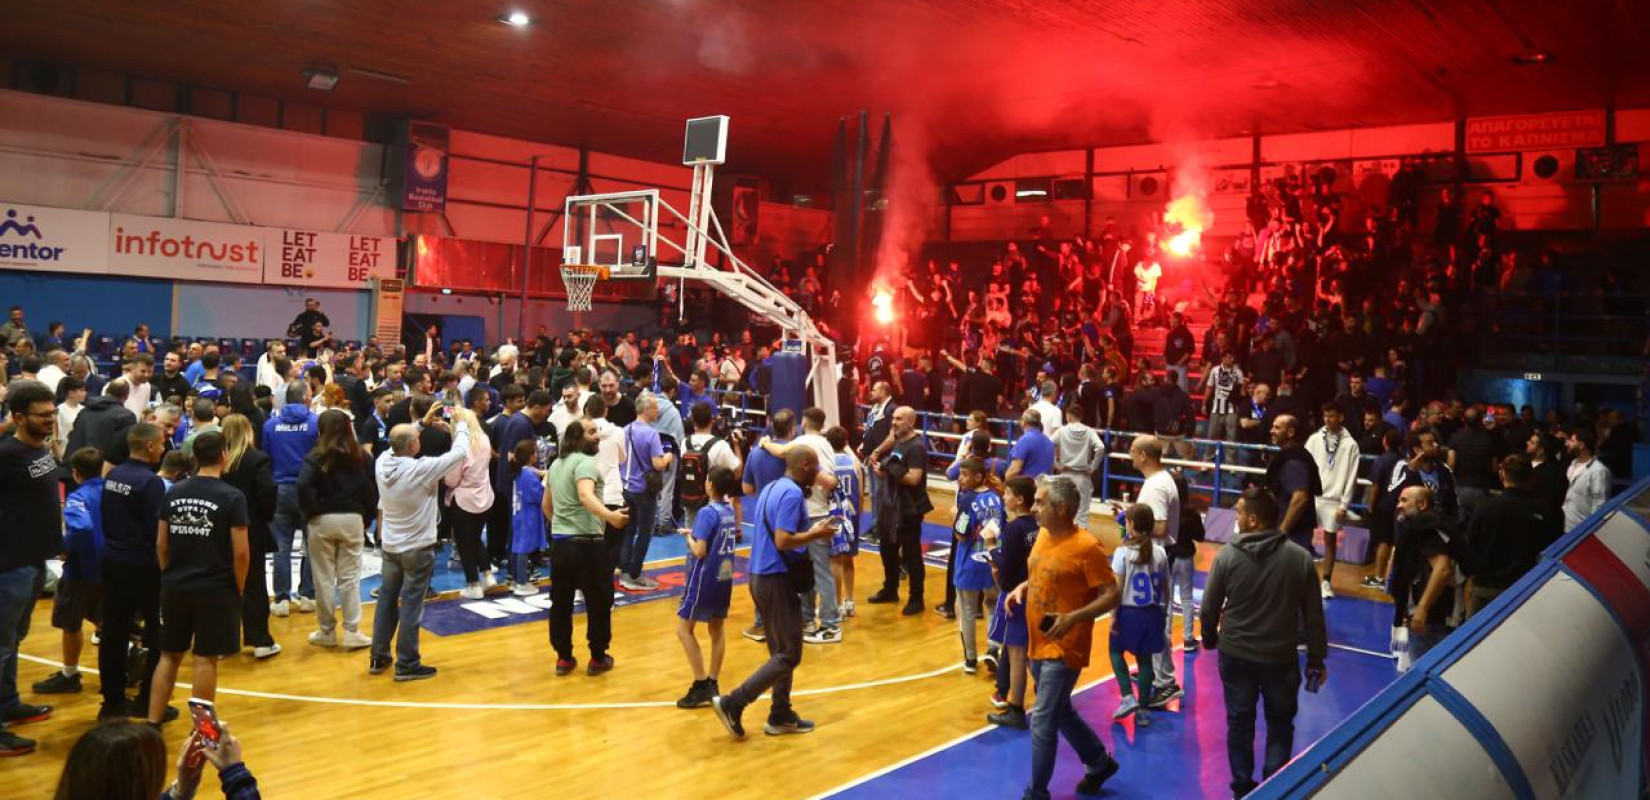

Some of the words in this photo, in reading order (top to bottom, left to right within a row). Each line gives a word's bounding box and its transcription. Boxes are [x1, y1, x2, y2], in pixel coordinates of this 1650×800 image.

[1469, 114, 1600, 133] ΑΠΑΓΟΡΕΥΕΤΑΙ
[1471, 137, 1492, 148] ΤΟ
[1500, 130, 1600, 147] ΚΑΠΝΙΣΜΑ
[116, 227, 258, 263] infotrust
[283, 231, 317, 247] LET
[349, 236, 381, 251] LET
[282, 247, 316, 263] EAT
[348, 252, 380, 267] EAT
